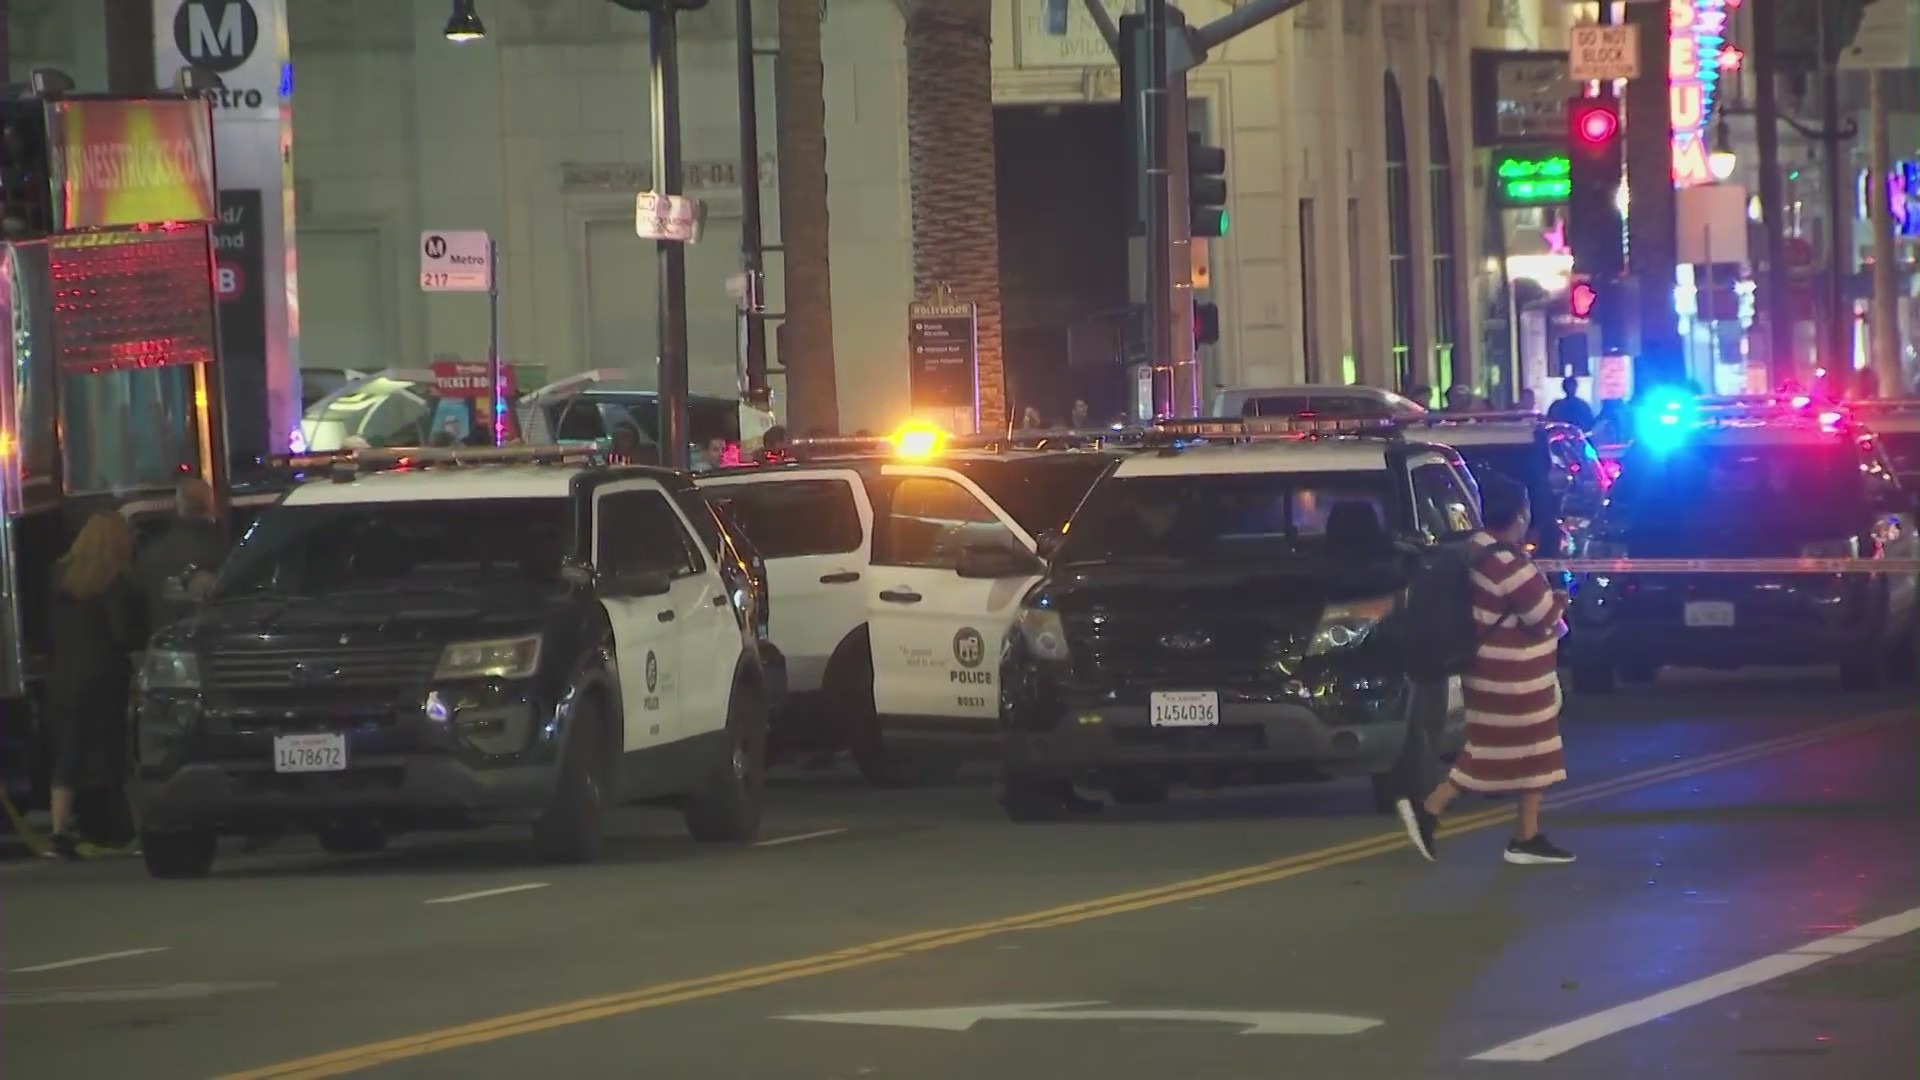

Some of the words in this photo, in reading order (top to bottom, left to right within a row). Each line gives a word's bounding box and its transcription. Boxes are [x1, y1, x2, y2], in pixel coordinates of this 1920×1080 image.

[188, 3, 244, 58] M
[1579, 31, 1597, 46] DO
[1603, 30, 1627, 45] NOT
[1583, 48, 1625, 63] BLOCK
[209, 88, 263, 109] etro
[450, 254, 485, 265] Metro
[217, 269, 235, 293] B
[424, 273, 449, 286] 217
[913, 305, 968, 315] HOLLYWOOD
[950, 670, 993, 685] POLICE
[1156, 704, 1214, 722] 1454036
[280, 747, 341, 767] 1478672
